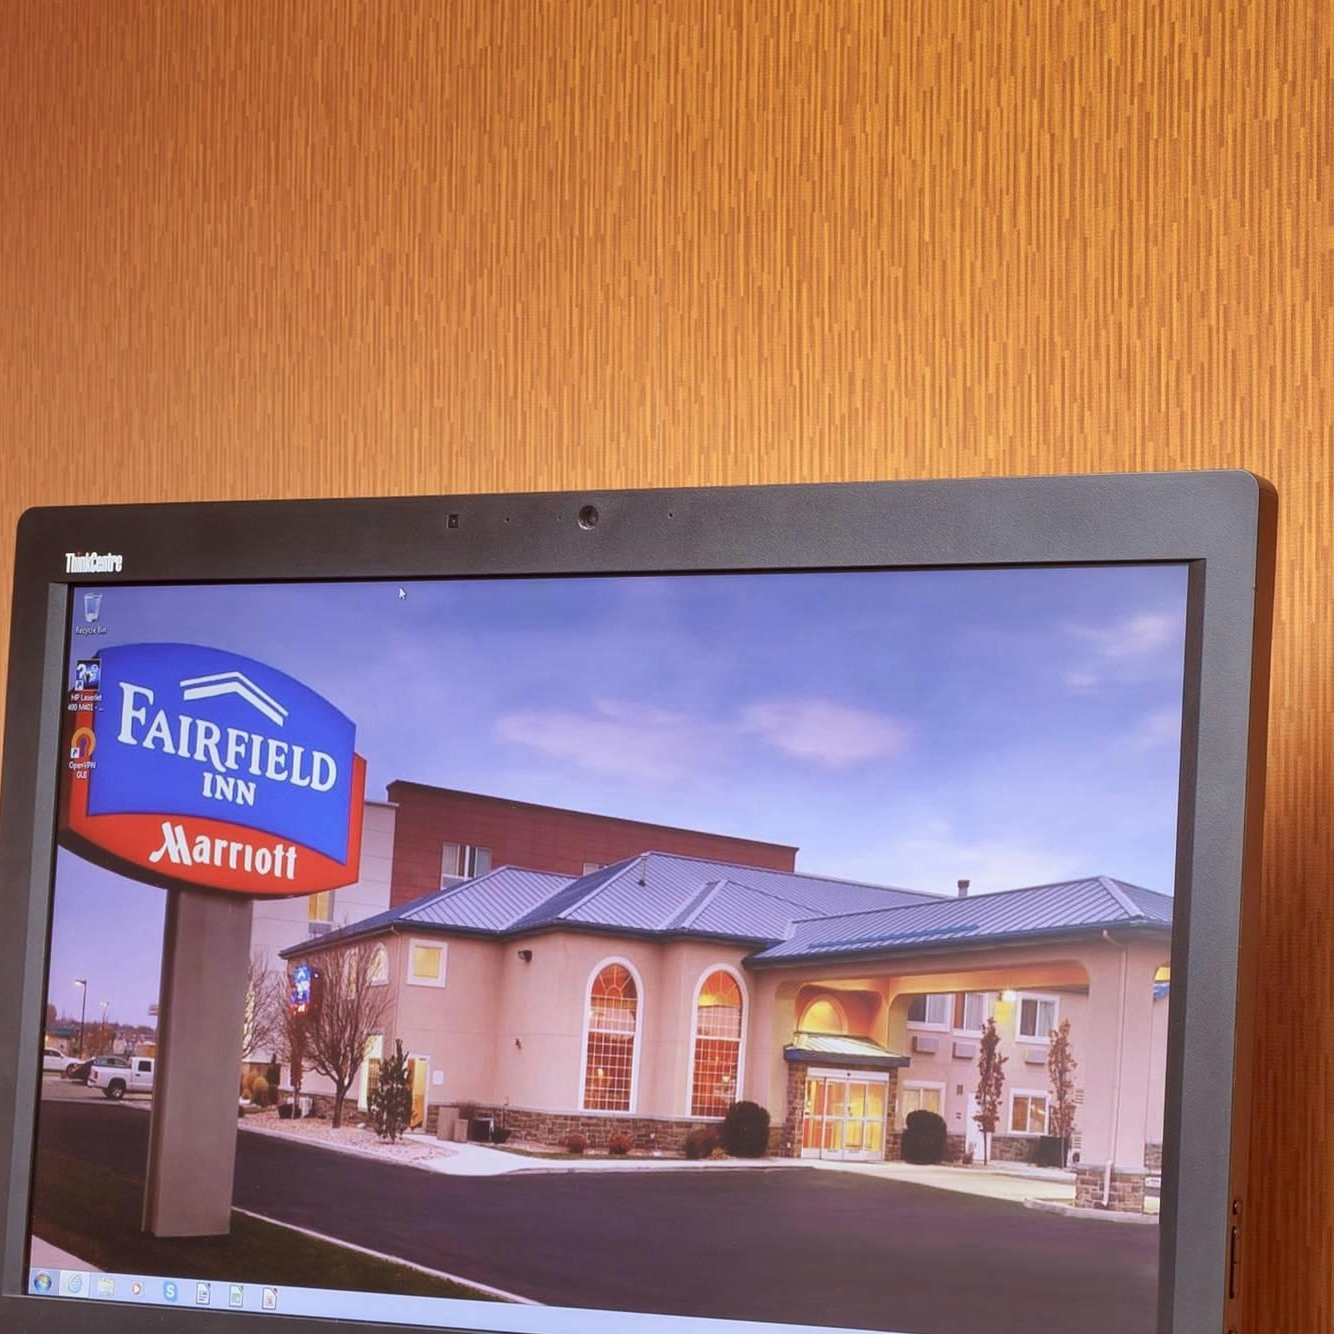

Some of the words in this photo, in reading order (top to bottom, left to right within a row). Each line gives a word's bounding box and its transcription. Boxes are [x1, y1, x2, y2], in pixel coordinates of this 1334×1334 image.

[65, 552, 123, 573] ThinkCentre
[75, 626, 96, 635] Recycle
[97, 626, 107, 634] Bin
[117, 681, 338, 792] FAIRFIELD
[69, 762, 96, 770] OpenVPN
[202, 772, 257, 806] INN
[149, 821, 297, 880] Marriott
